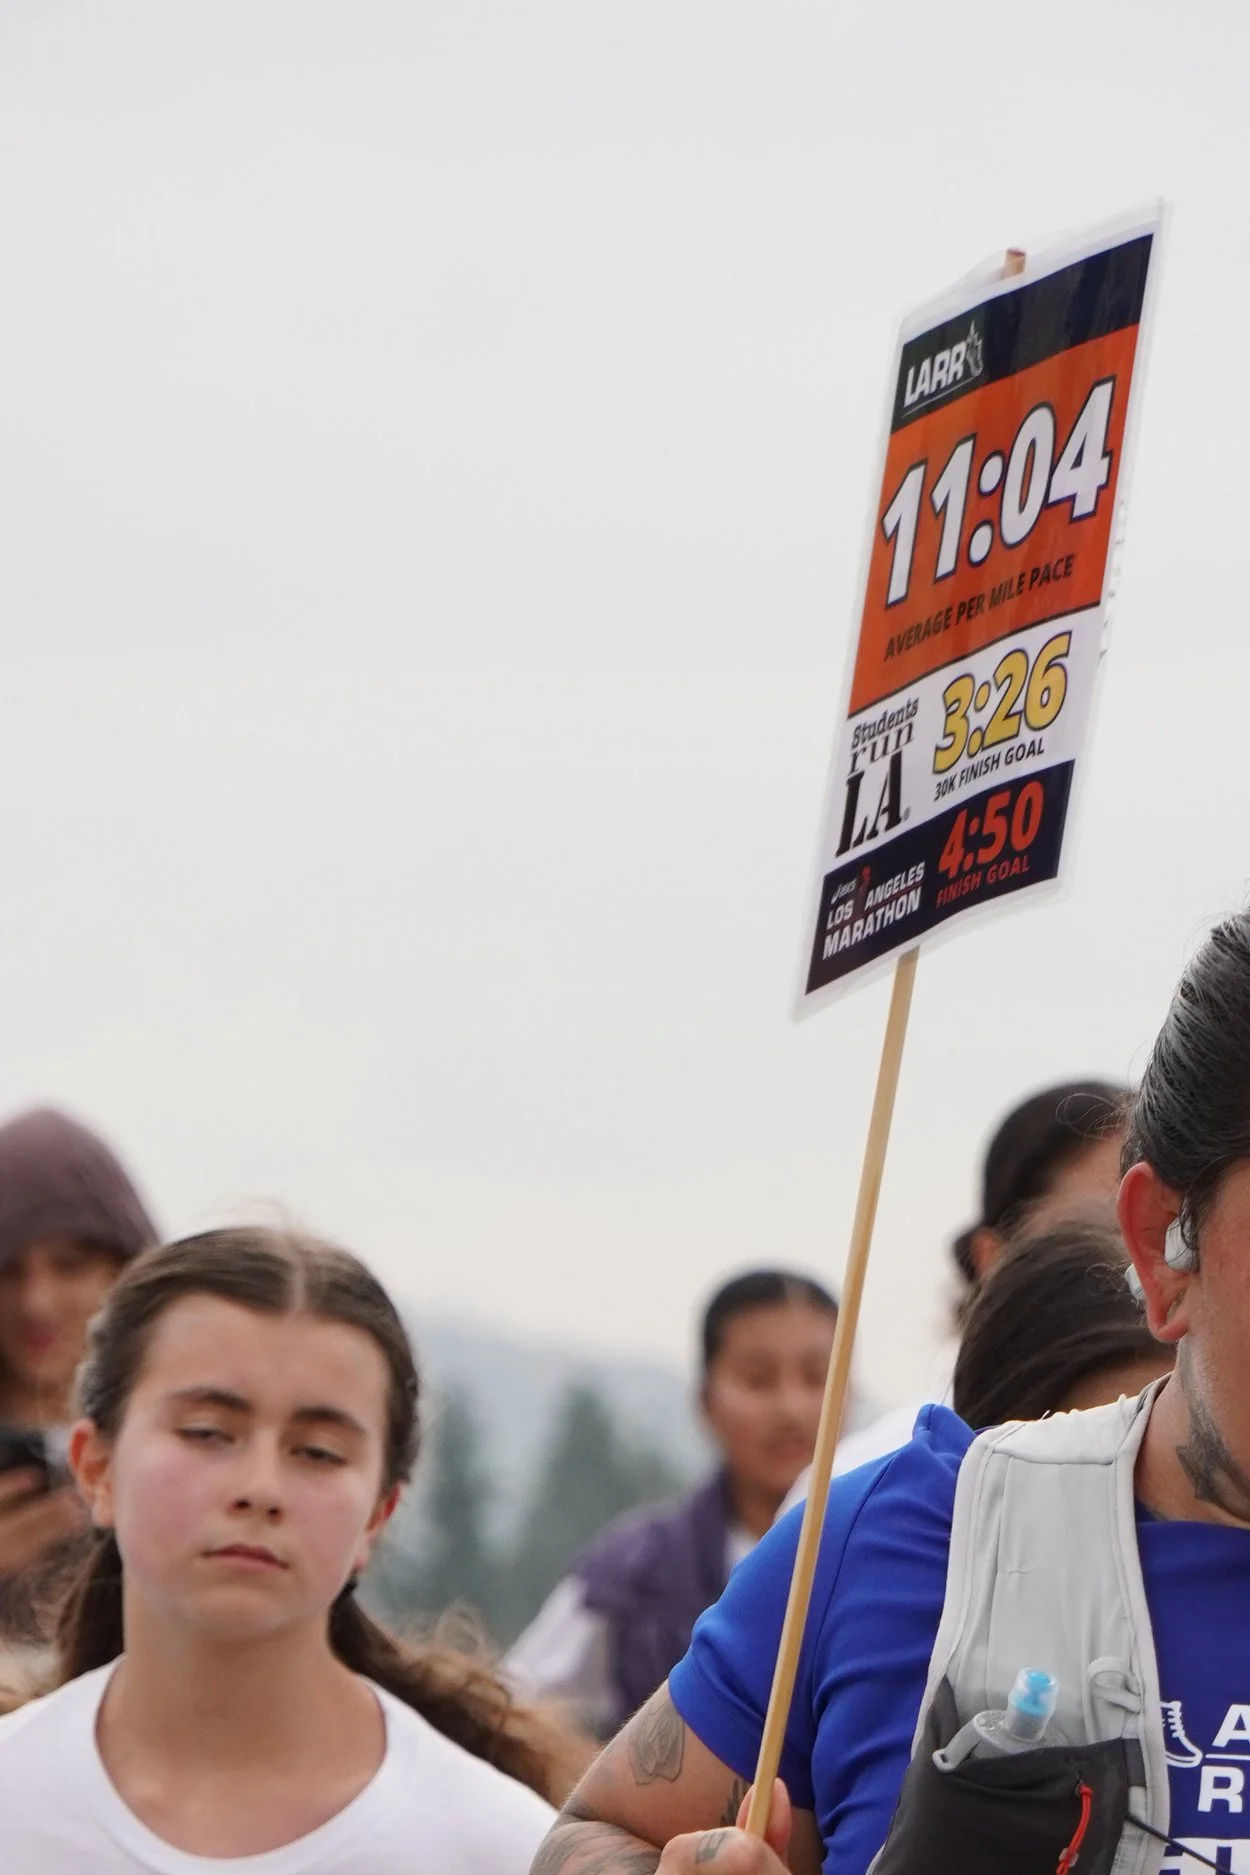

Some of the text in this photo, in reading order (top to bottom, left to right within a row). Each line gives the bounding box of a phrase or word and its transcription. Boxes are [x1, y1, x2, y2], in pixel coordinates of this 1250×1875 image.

[903, 339, 968, 409] LARR
[881, 375, 1117, 610] 11:04
[884, 554, 1075, 661] AVERAGE PER MILE PACE
[851, 697, 919, 750] Students
[932, 631, 1072, 774] 3:26
[847, 721, 914, 776] run
[934, 737, 1044, 801] 30K FINISH GOAL
[834, 750, 904, 858] LA
[938, 779, 1044, 879] 4:50
[827, 861, 925, 930] LOS ANGELES
[936, 855, 1030, 908] FINISH GOAL
[823, 885, 922, 960] MARATHON
